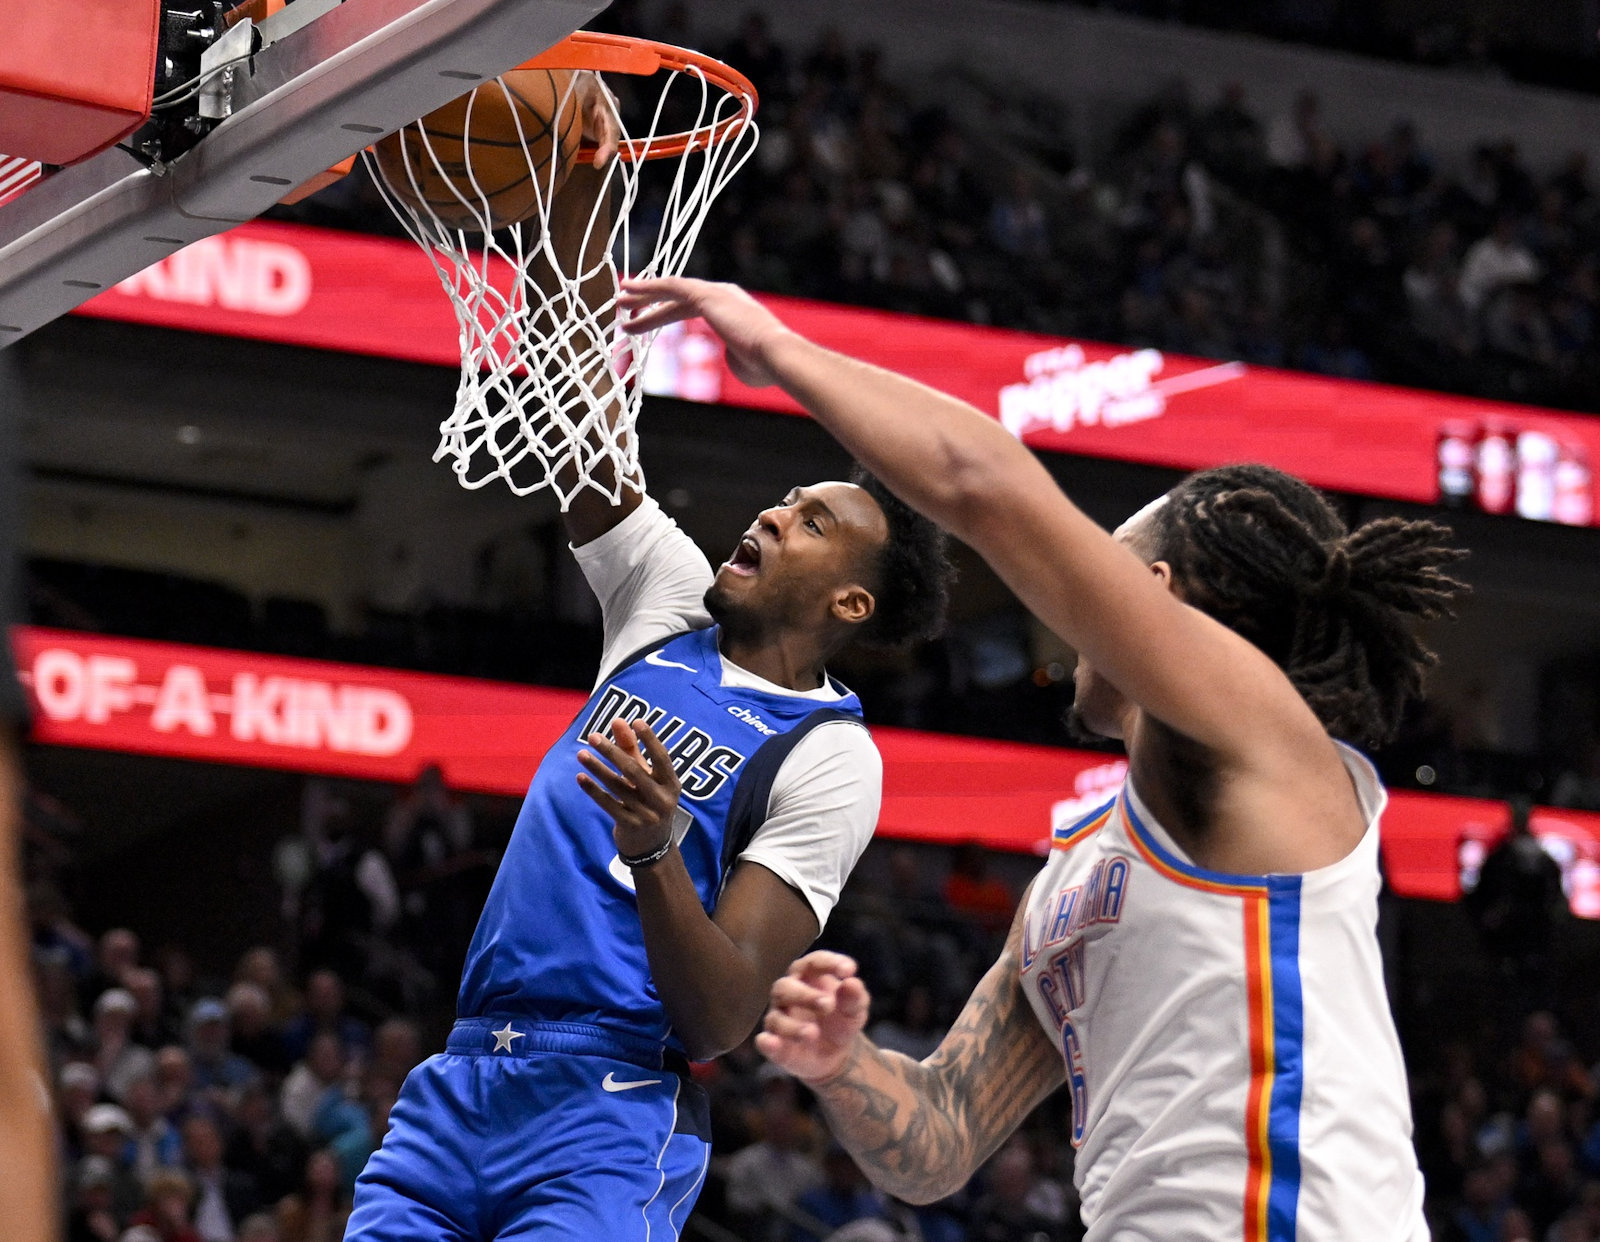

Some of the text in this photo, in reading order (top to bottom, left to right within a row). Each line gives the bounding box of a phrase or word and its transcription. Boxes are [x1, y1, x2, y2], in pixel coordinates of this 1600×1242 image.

[577, 684, 746, 800] DAAS
[727, 706, 778, 736] chime
[1060, 1015, 1089, 1149] 6
